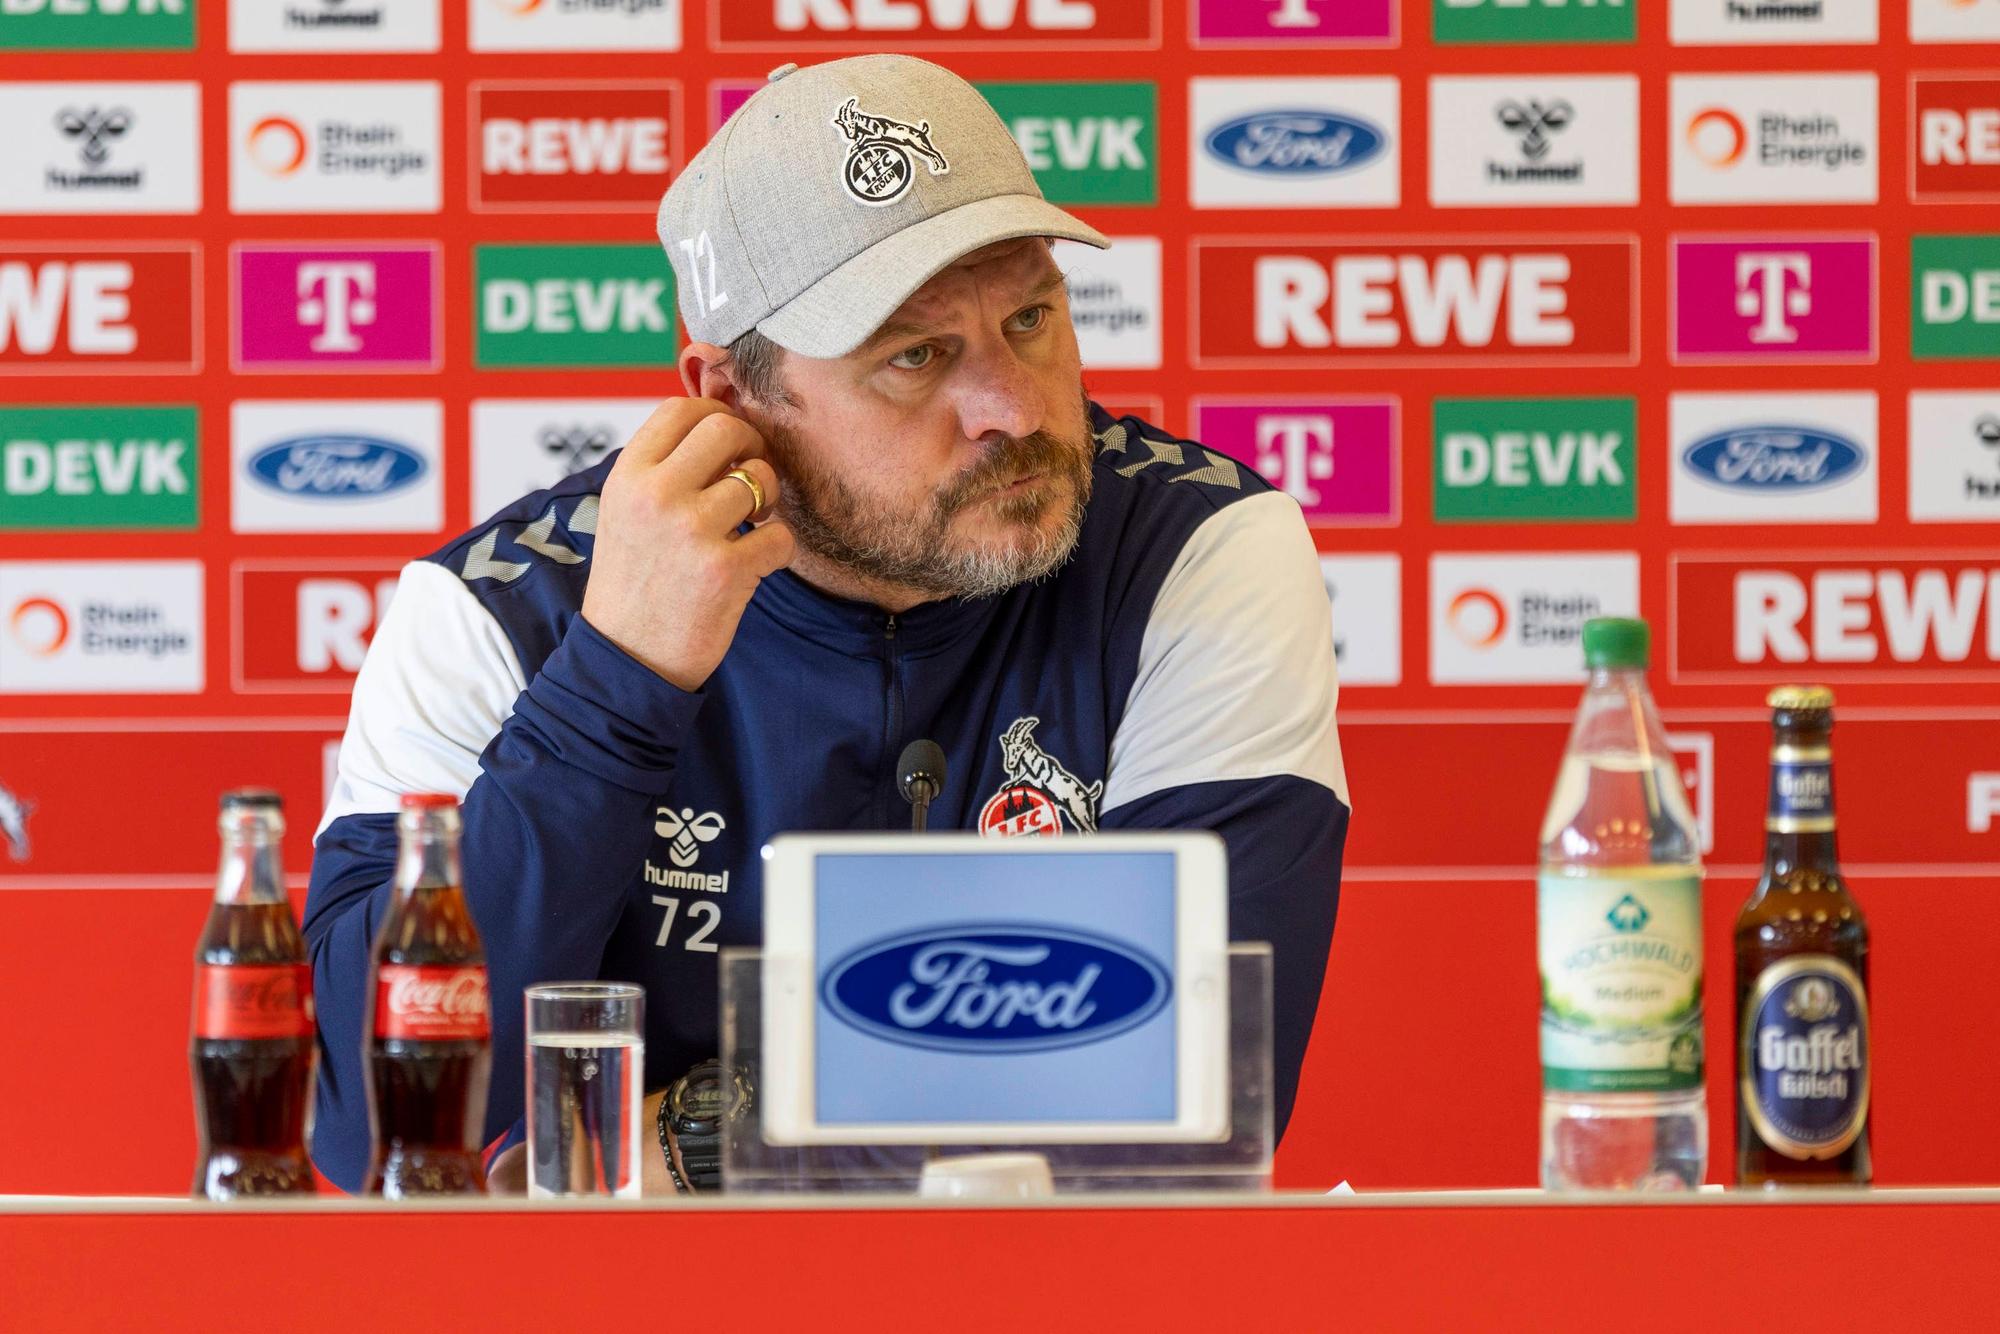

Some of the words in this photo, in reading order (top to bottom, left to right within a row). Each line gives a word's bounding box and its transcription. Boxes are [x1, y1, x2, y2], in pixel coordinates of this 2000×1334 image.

[1727, 1, 1822, 22] hummel
[319, 123, 397, 147] Rhein
[483, 118, 669, 174] REWE
[1014, 117, 1145, 170] EVK
[1237, 119, 1354, 168] Ford
[1758, 114, 1839, 139] Rhein
[47, 167, 142, 190] hummel
[319, 150, 425, 176] Energie
[1487, 161, 1582, 184] hummel
[1758, 143, 1866, 170] Energie
[874, 171, 896, 193] KÖLN
[297, 261, 376, 353] T
[484, 278, 668, 333] DEVK
[1254, 254, 1574, 348] REWE
[1735, 252, 1812, 344] T
[5, 440, 188, 495] DEVK
[277, 443, 398, 491] Ford
[1442, 432, 1625, 487] DEVK
[1715, 434, 1831, 483] Ford
[81, 603, 161, 625] Rhein
[1520, 595, 1599, 619] Rhein
[1734, 570, 2000, 663] REW
[81, 630, 189, 657] Energie
[644, 859, 730, 893] hummel
[652, 894, 721, 953] 72
[888, 940, 1102, 1029] Ford
[1758, 1022, 1862, 1075] Gaffel
[1777, 1072, 1849, 1101] Kölsch
